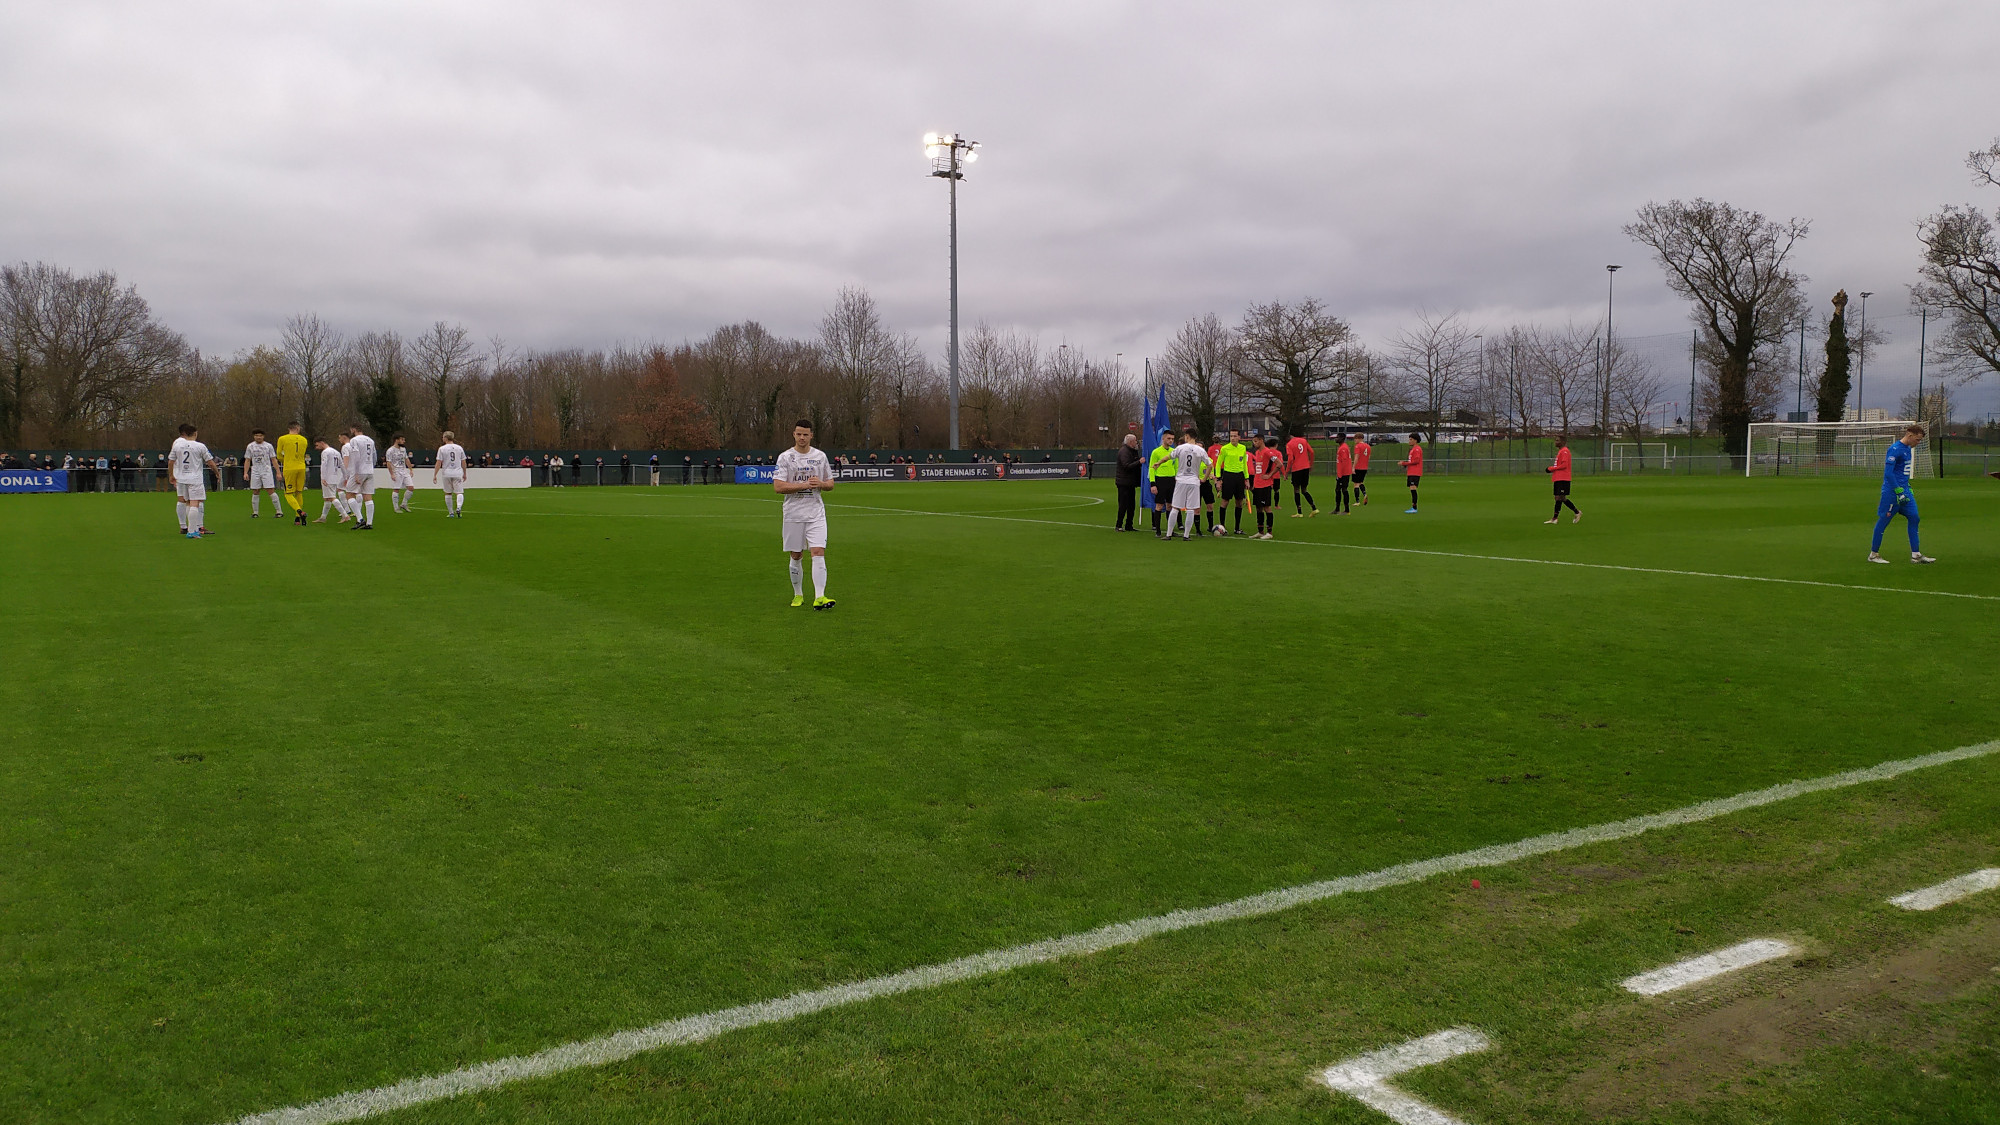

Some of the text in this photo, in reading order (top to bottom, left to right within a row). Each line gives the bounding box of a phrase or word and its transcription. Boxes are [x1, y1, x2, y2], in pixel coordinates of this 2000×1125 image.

[294, 441, 299, 453] 1
[366, 444, 371, 456] 5
[1297, 443, 1304, 454] 9
[1363, 447, 1368, 457] 4
[183, 451, 190, 464] 2
[449, 451, 456, 462] 9
[1186, 454, 1193, 467] 8
[746, 470, 756, 478] N3
[921, 468, 990, 477] STADE RENNAIS F.C.
[1024, 467, 1041, 475] Mutuel
[1047, 466, 1069, 475] Bretagne
[44, 475, 53, 486] 3
